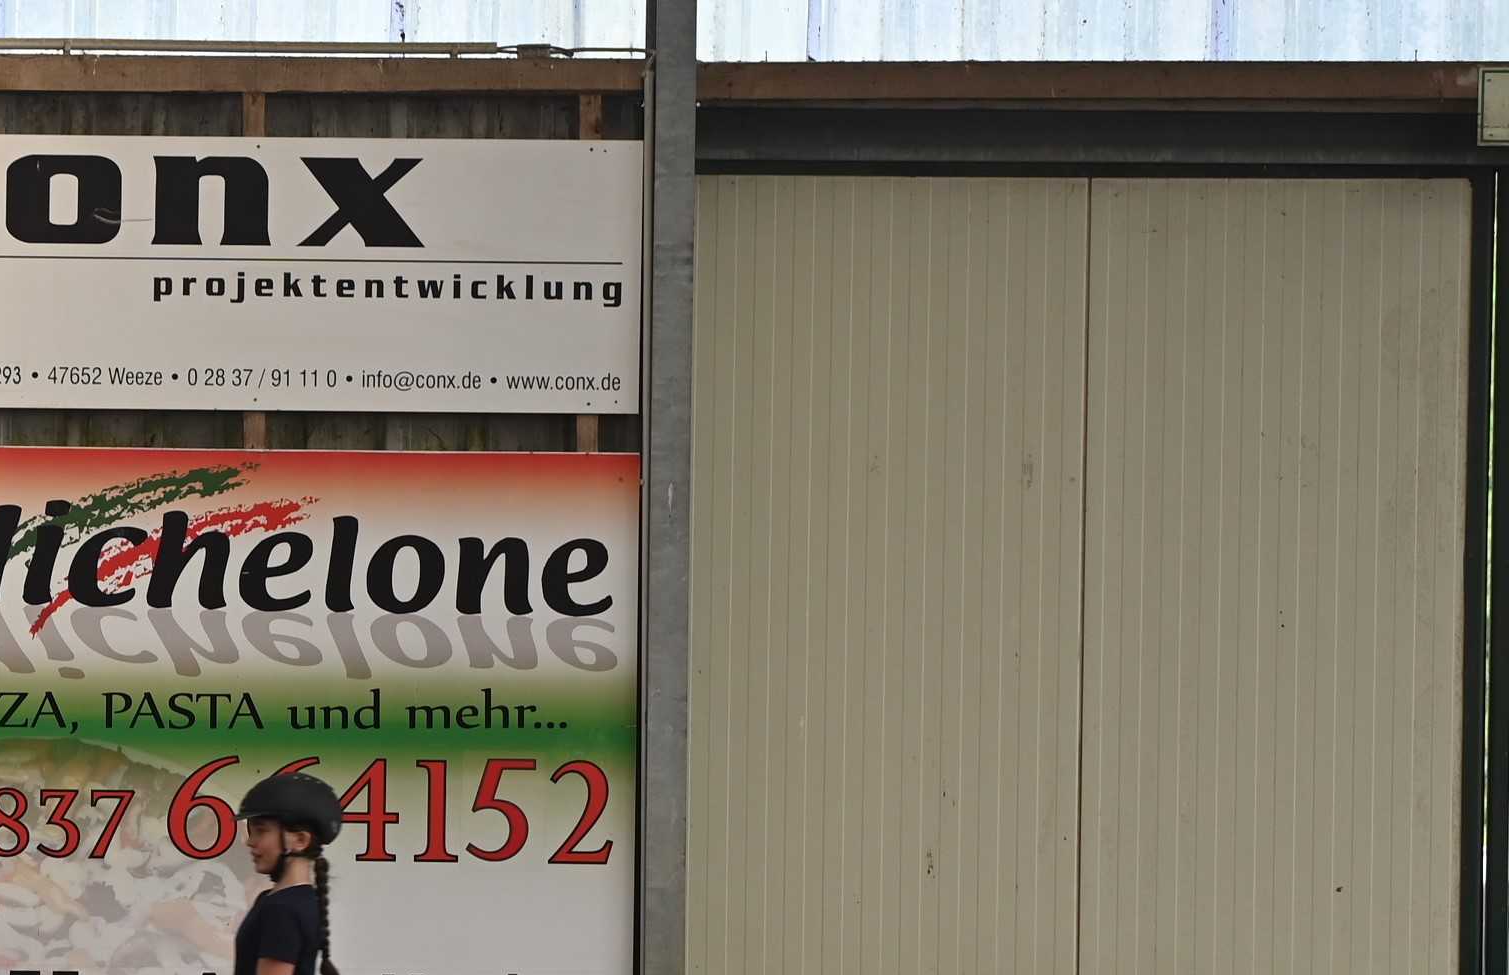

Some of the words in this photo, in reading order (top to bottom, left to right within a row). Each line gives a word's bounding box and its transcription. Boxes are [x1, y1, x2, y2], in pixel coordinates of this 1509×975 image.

[152, 272, 623, 309] projektentwicklung
[48, 367, 101, 384] 47652
[109, 368, 162, 385] Weeze
[188, 368, 197, 385] 0
[205, 368, 225, 386] 28
[232, 369, 253, 386] 37
[272, 369, 289, 387] 91
[301, 370, 317, 387] 11
[327, 370, 336, 387] 0
[363, 370, 481, 391] info@conx.de
[507, 373, 620, 391] www.conx.de
[102, 692, 264, 729] PASTA
[287, 689, 380, 730] und
[405, 688, 567, 729] mehr...
[166, 755, 614, 865] 64152
